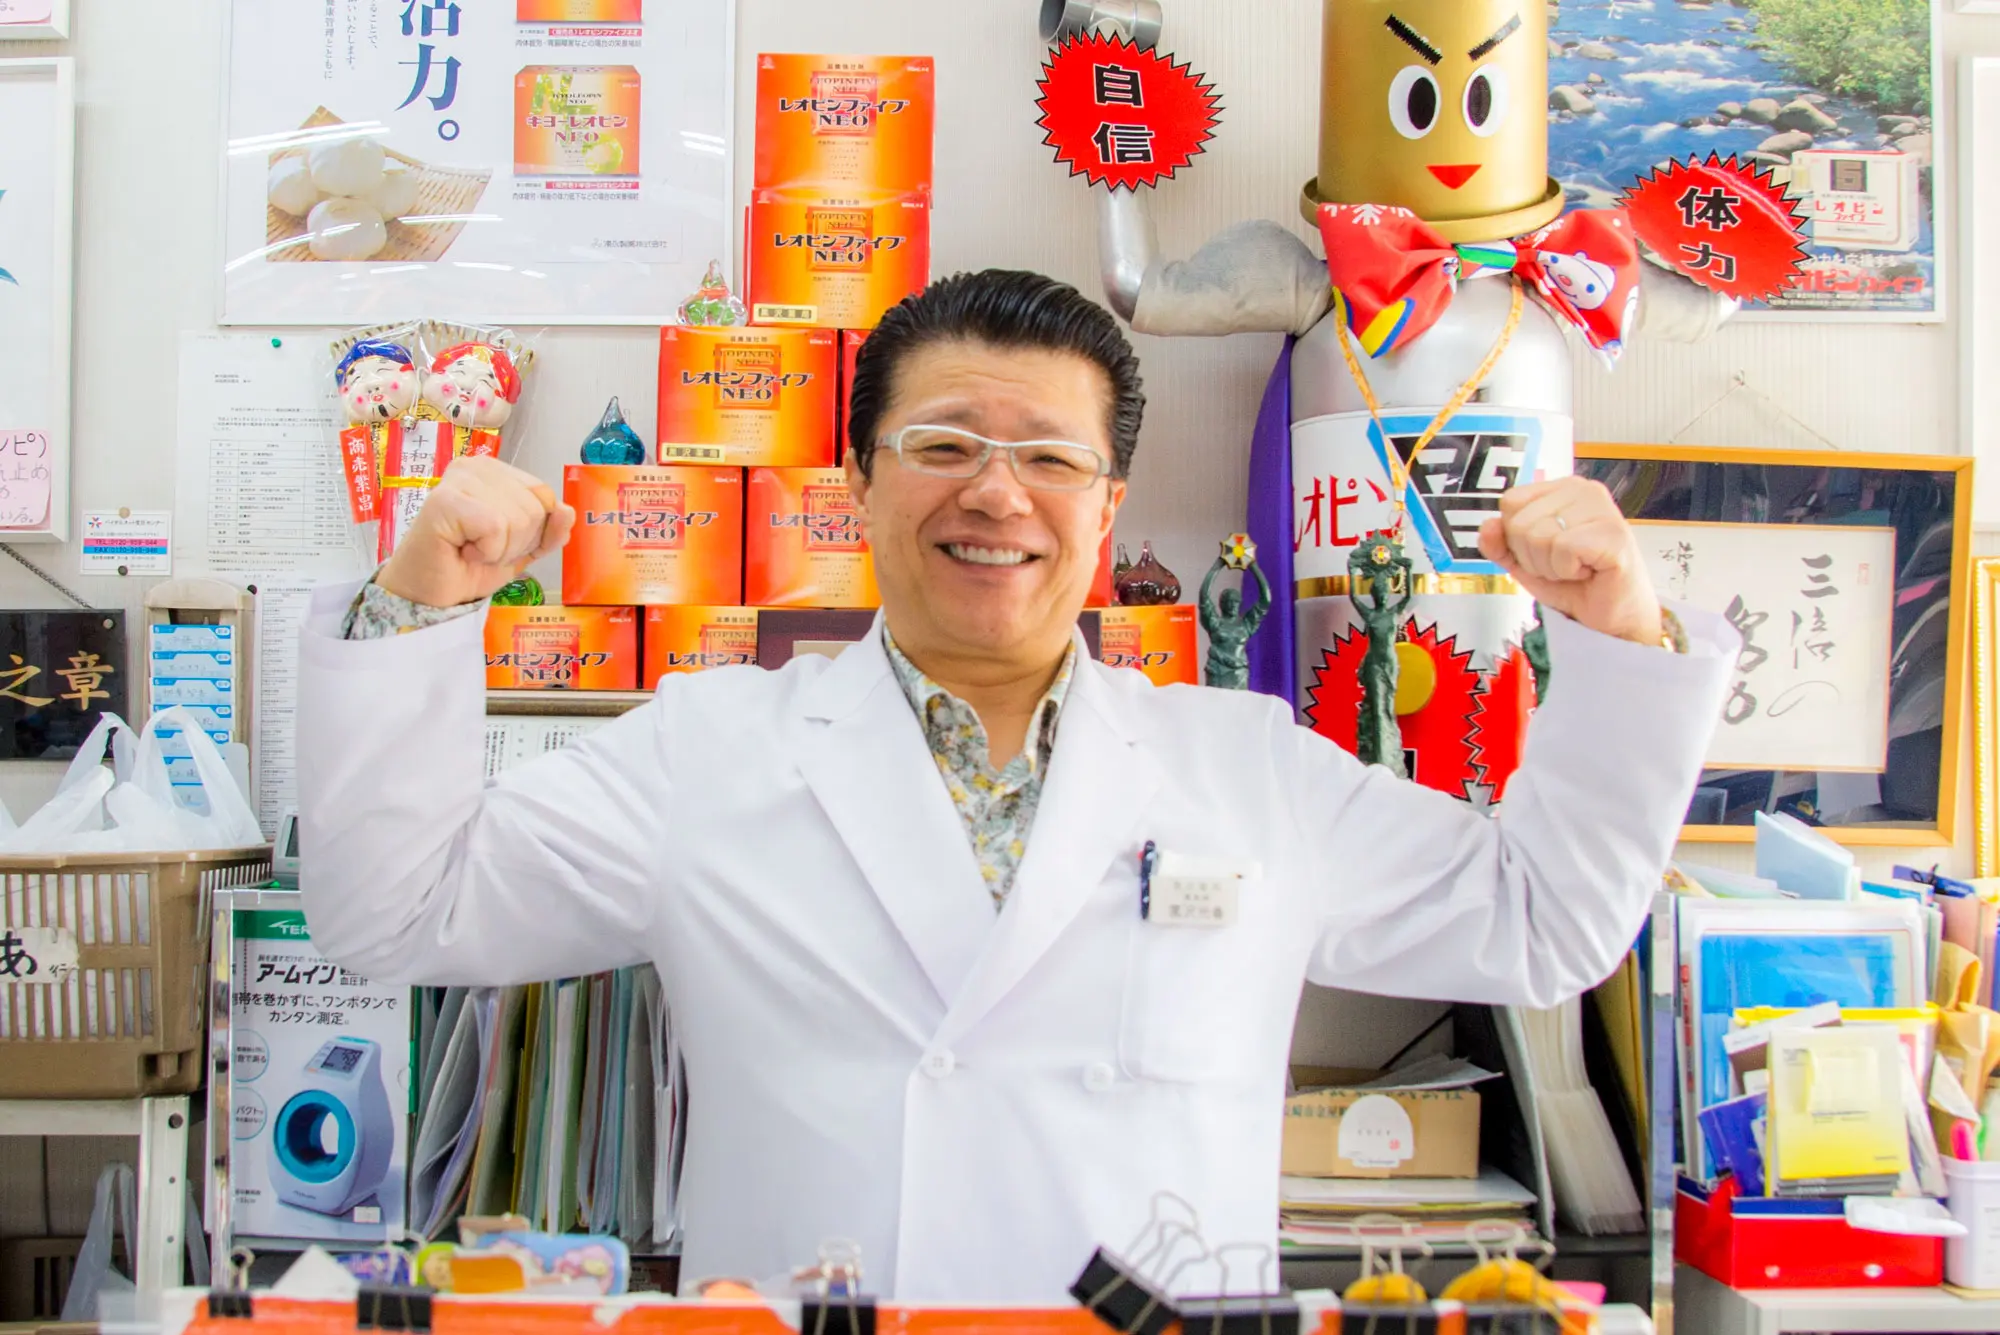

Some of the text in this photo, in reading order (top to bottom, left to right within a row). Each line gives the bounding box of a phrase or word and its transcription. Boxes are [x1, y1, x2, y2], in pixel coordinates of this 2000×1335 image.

[346, 0, 358, 71] いいたします。
[818, 114, 868, 127] NEO
[1091, 63, 1155, 164] 自信
[527, 114, 628, 129] キヨーレオピン
[554, 131, 600, 143] NEO
[1815, 200, 1884, 215] レオピン
[1676, 186, 1741, 283] 体力
[814, 251, 865, 263] NEO
[722, 388, 773, 400] NEO
[409, 434, 429, 503] 十和田社
[626, 528, 677, 540] NEO
[810, 530, 861, 542] NEO
[0, 650, 115, 711] 之章
[520, 668, 573, 681] NEO
[0, 930, 38, 978] あ
[256, 963, 337, 984] アームイン
[269, 1010, 350, 1025] カンタン測定。
